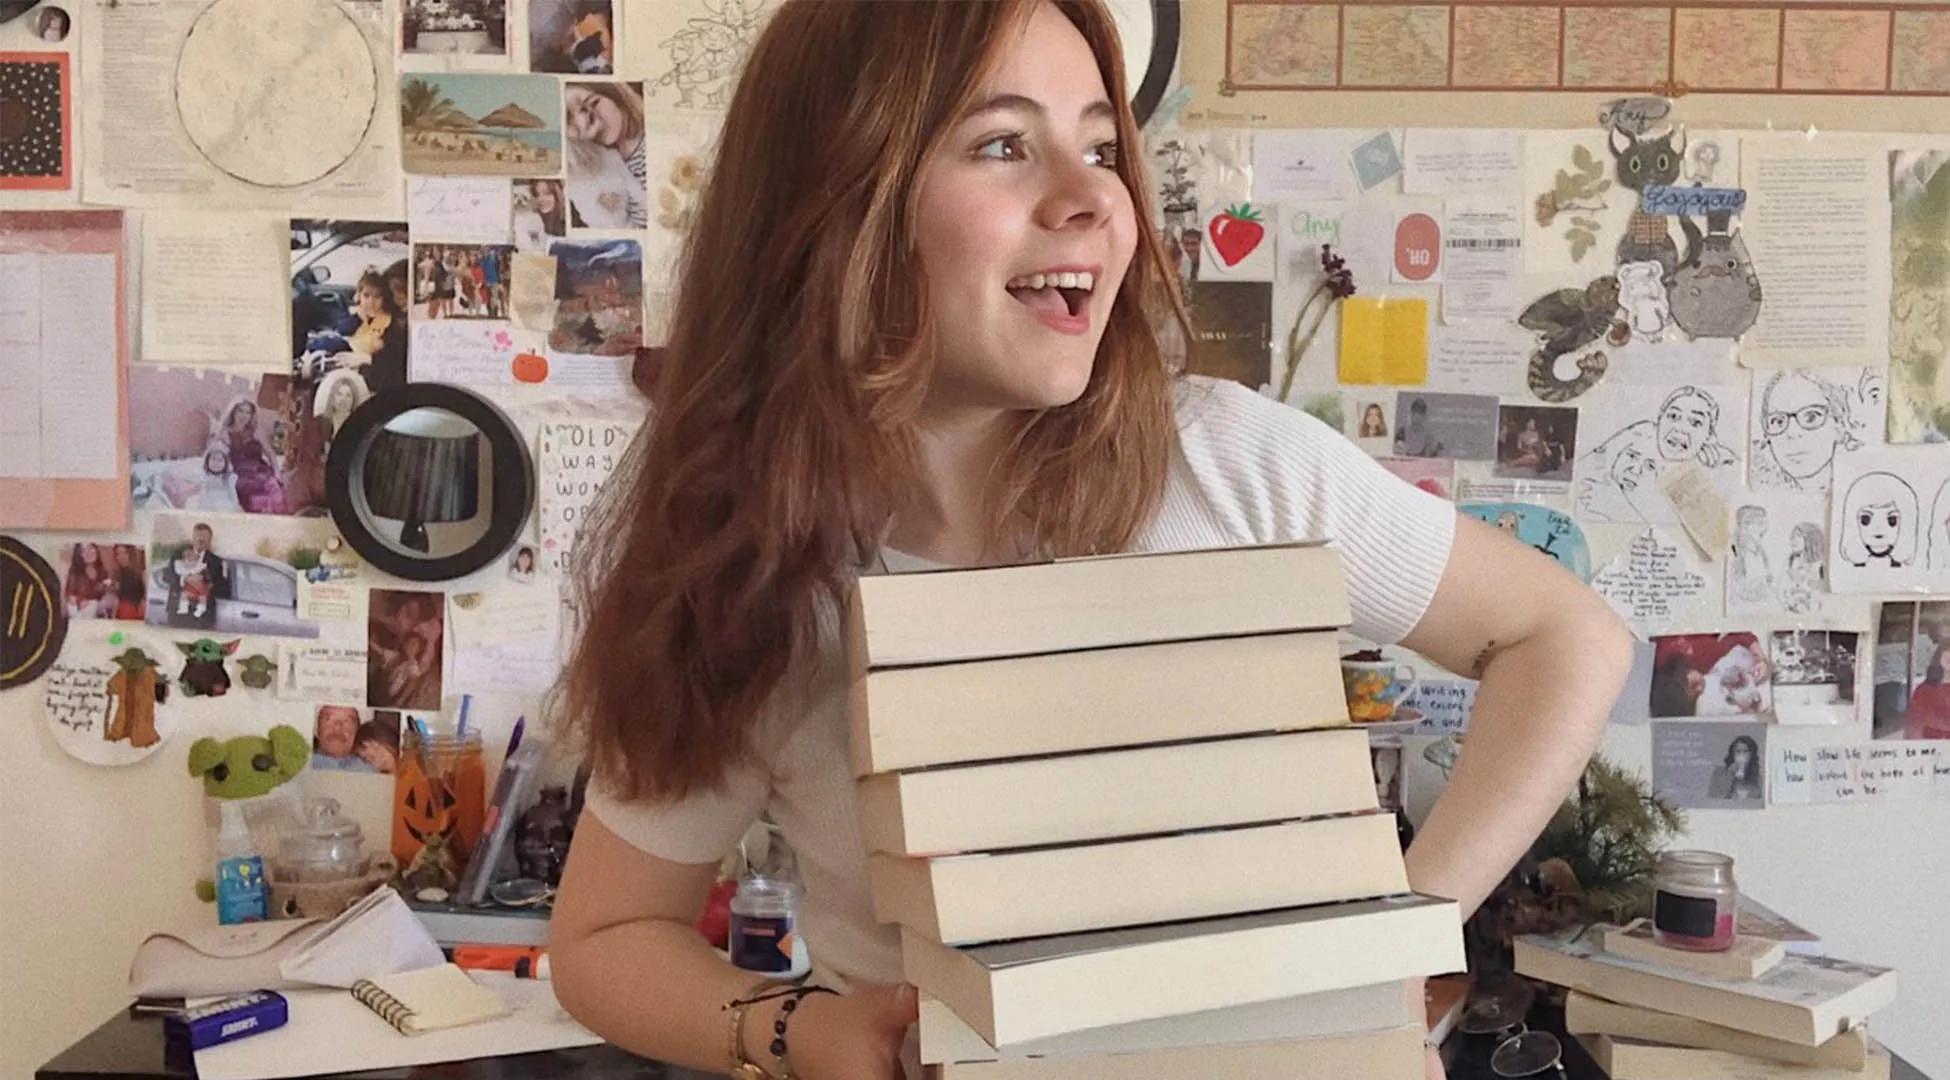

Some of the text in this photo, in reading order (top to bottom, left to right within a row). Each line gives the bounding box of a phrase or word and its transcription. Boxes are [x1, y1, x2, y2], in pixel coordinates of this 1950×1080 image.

[571, 427, 615, 447] OLD
[562, 454, 613, 473] WAY
[1783, 749, 1808, 762] How
[1906, 747, 1917, 758] to
